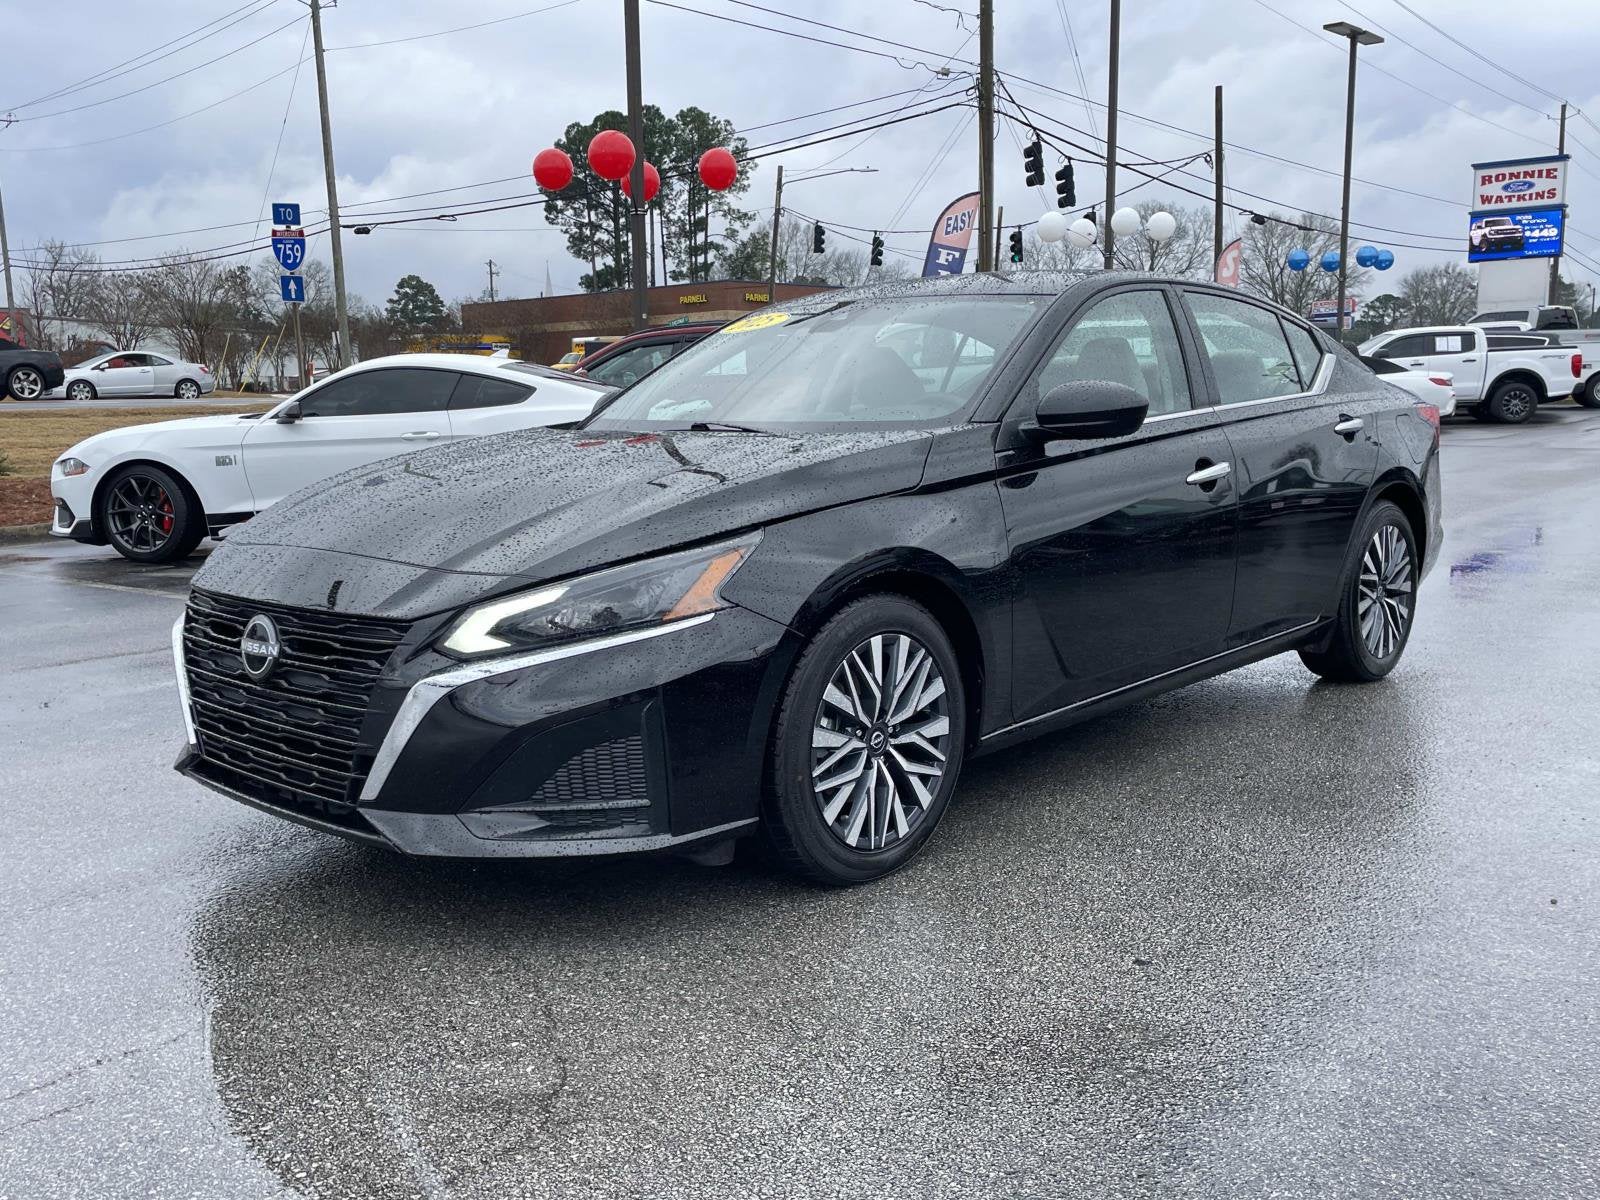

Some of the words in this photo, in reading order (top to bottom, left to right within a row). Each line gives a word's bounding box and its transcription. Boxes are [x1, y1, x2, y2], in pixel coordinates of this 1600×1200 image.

[1480, 167, 1558, 187] RONNIE
[1507, 181, 1530, 192] Ford
[1480, 187, 1557, 205] WATKINS
[279, 208, 293, 221] TO
[944, 209, 974, 236] EASY
[1524, 227, 1559, 238] $449
[277, 244, 301, 263] 759
[680, 294, 707, 304] PARNELL
[745, 293, 769, 302] PARNE
